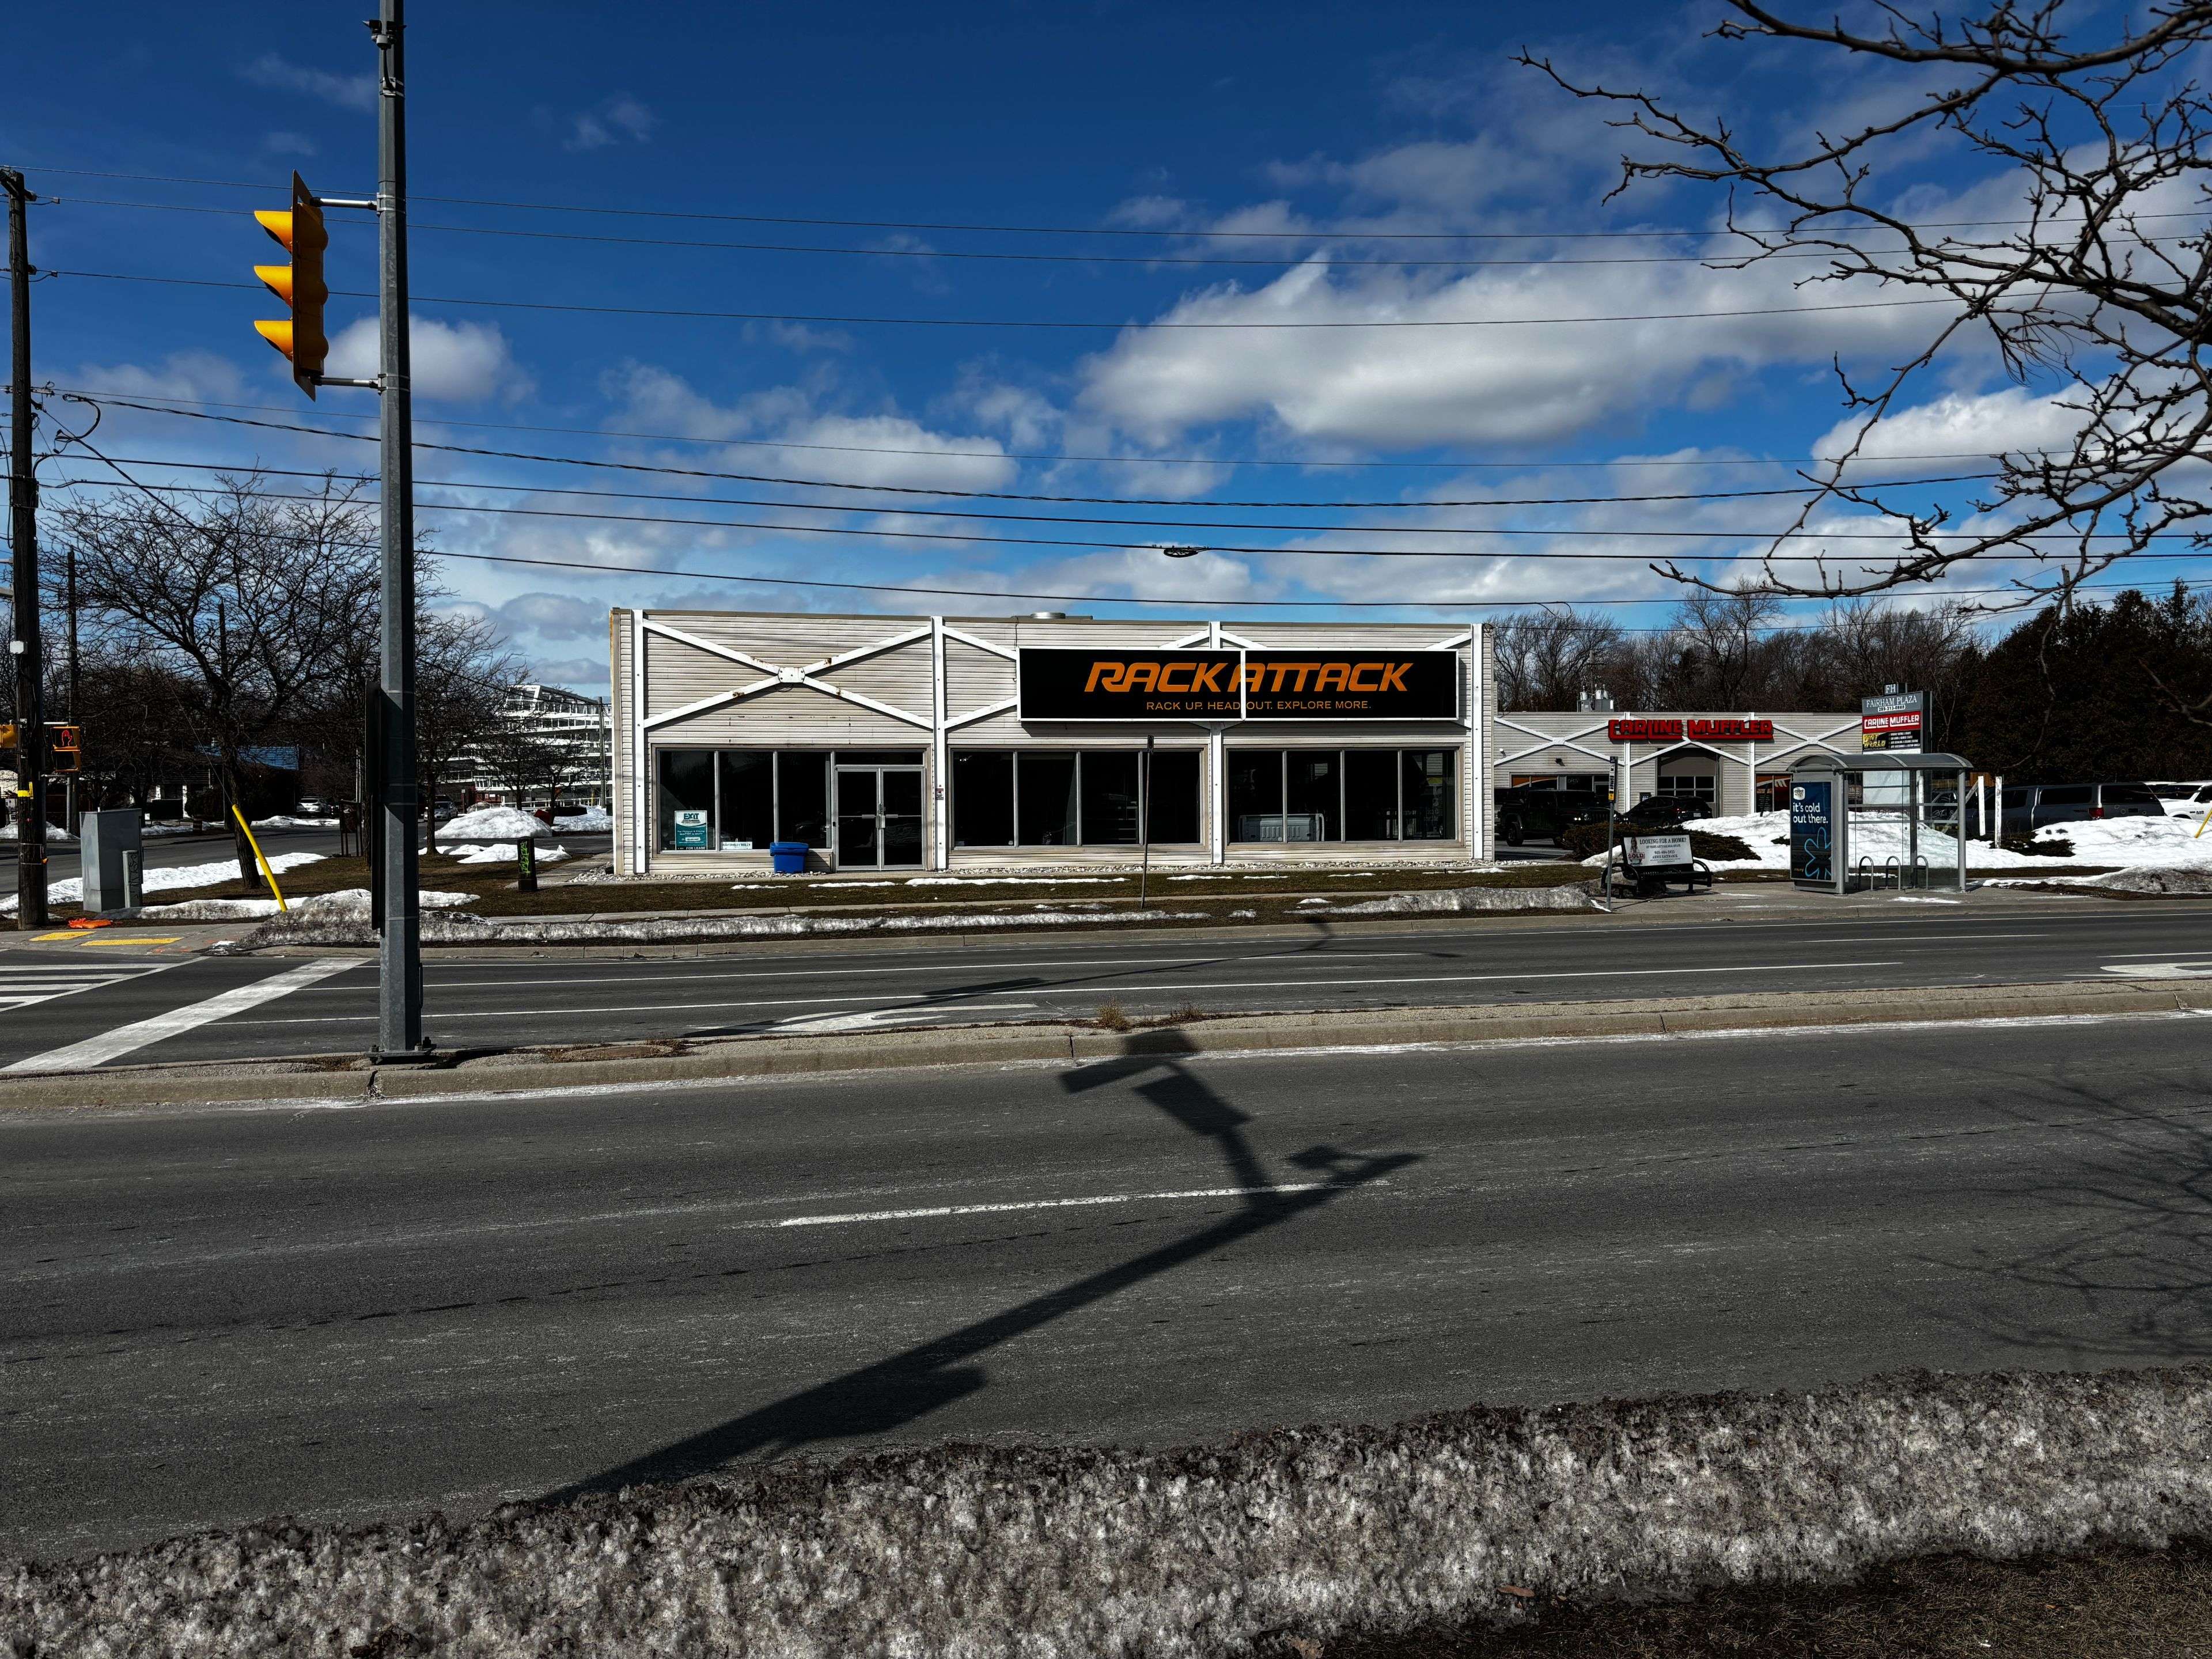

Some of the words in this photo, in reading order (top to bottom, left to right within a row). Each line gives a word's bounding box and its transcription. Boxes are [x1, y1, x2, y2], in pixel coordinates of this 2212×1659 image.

[1084, 662, 1228, 692] RACK
[1227, 662, 1414, 692] ATTACK
[1885, 684, 1896, 694] FH
[1146, 702, 1181, 710] RACK
[1208, 702, 1241, 710] HEAD
[1277, 701, 1332, 710] EXPLORE
[1336, 700, 1372, 709] MORE.
[1866, 698, 1895, 708] FAIRHAM
[1896, 695, 1917, 705] PLAZA
[1889, 715, 1919, 727] MUFFLER
[1687, 719, 1774, 740] MUFFLER
[1805, 802, 1820, 812] cold
[1793, 814, 1806, 823] out
[1808, 813, 1828, 824] there.
